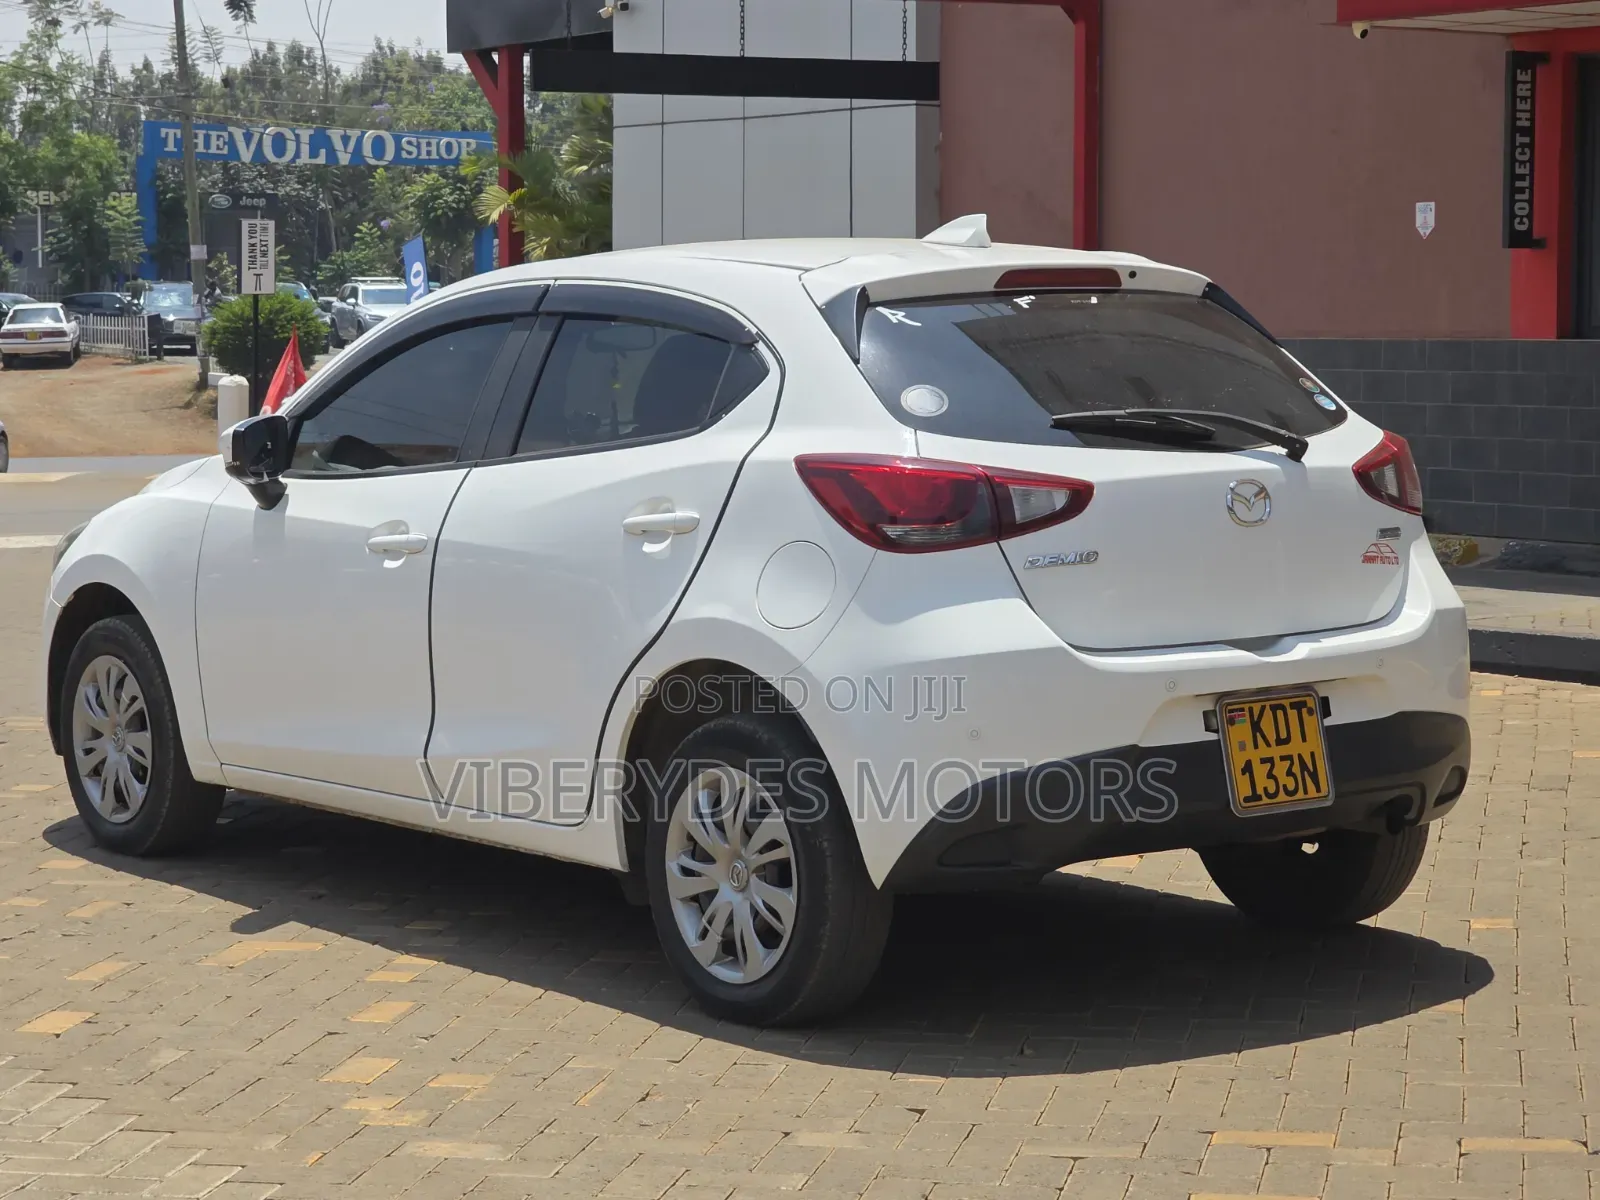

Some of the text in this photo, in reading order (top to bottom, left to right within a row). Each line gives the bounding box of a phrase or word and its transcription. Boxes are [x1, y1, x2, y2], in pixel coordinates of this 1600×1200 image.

[228, 126, 395, 166] VOLVO
[401, 137, 476, 160] SHOP
[1514, 69, 1531, 231] COLLECT HERE
[239, 196, 266, 207] Jeep
[247, 222, 258, 271] THANK YOU
[259, 222, 270, 237] TIME
[259, 239, 269, 259] NEXT
[1023, 550, 1099, 570] DEMIO
[1248, 700, 1308, 750] KDT
[1241, 751, 1321, 803] 133N
